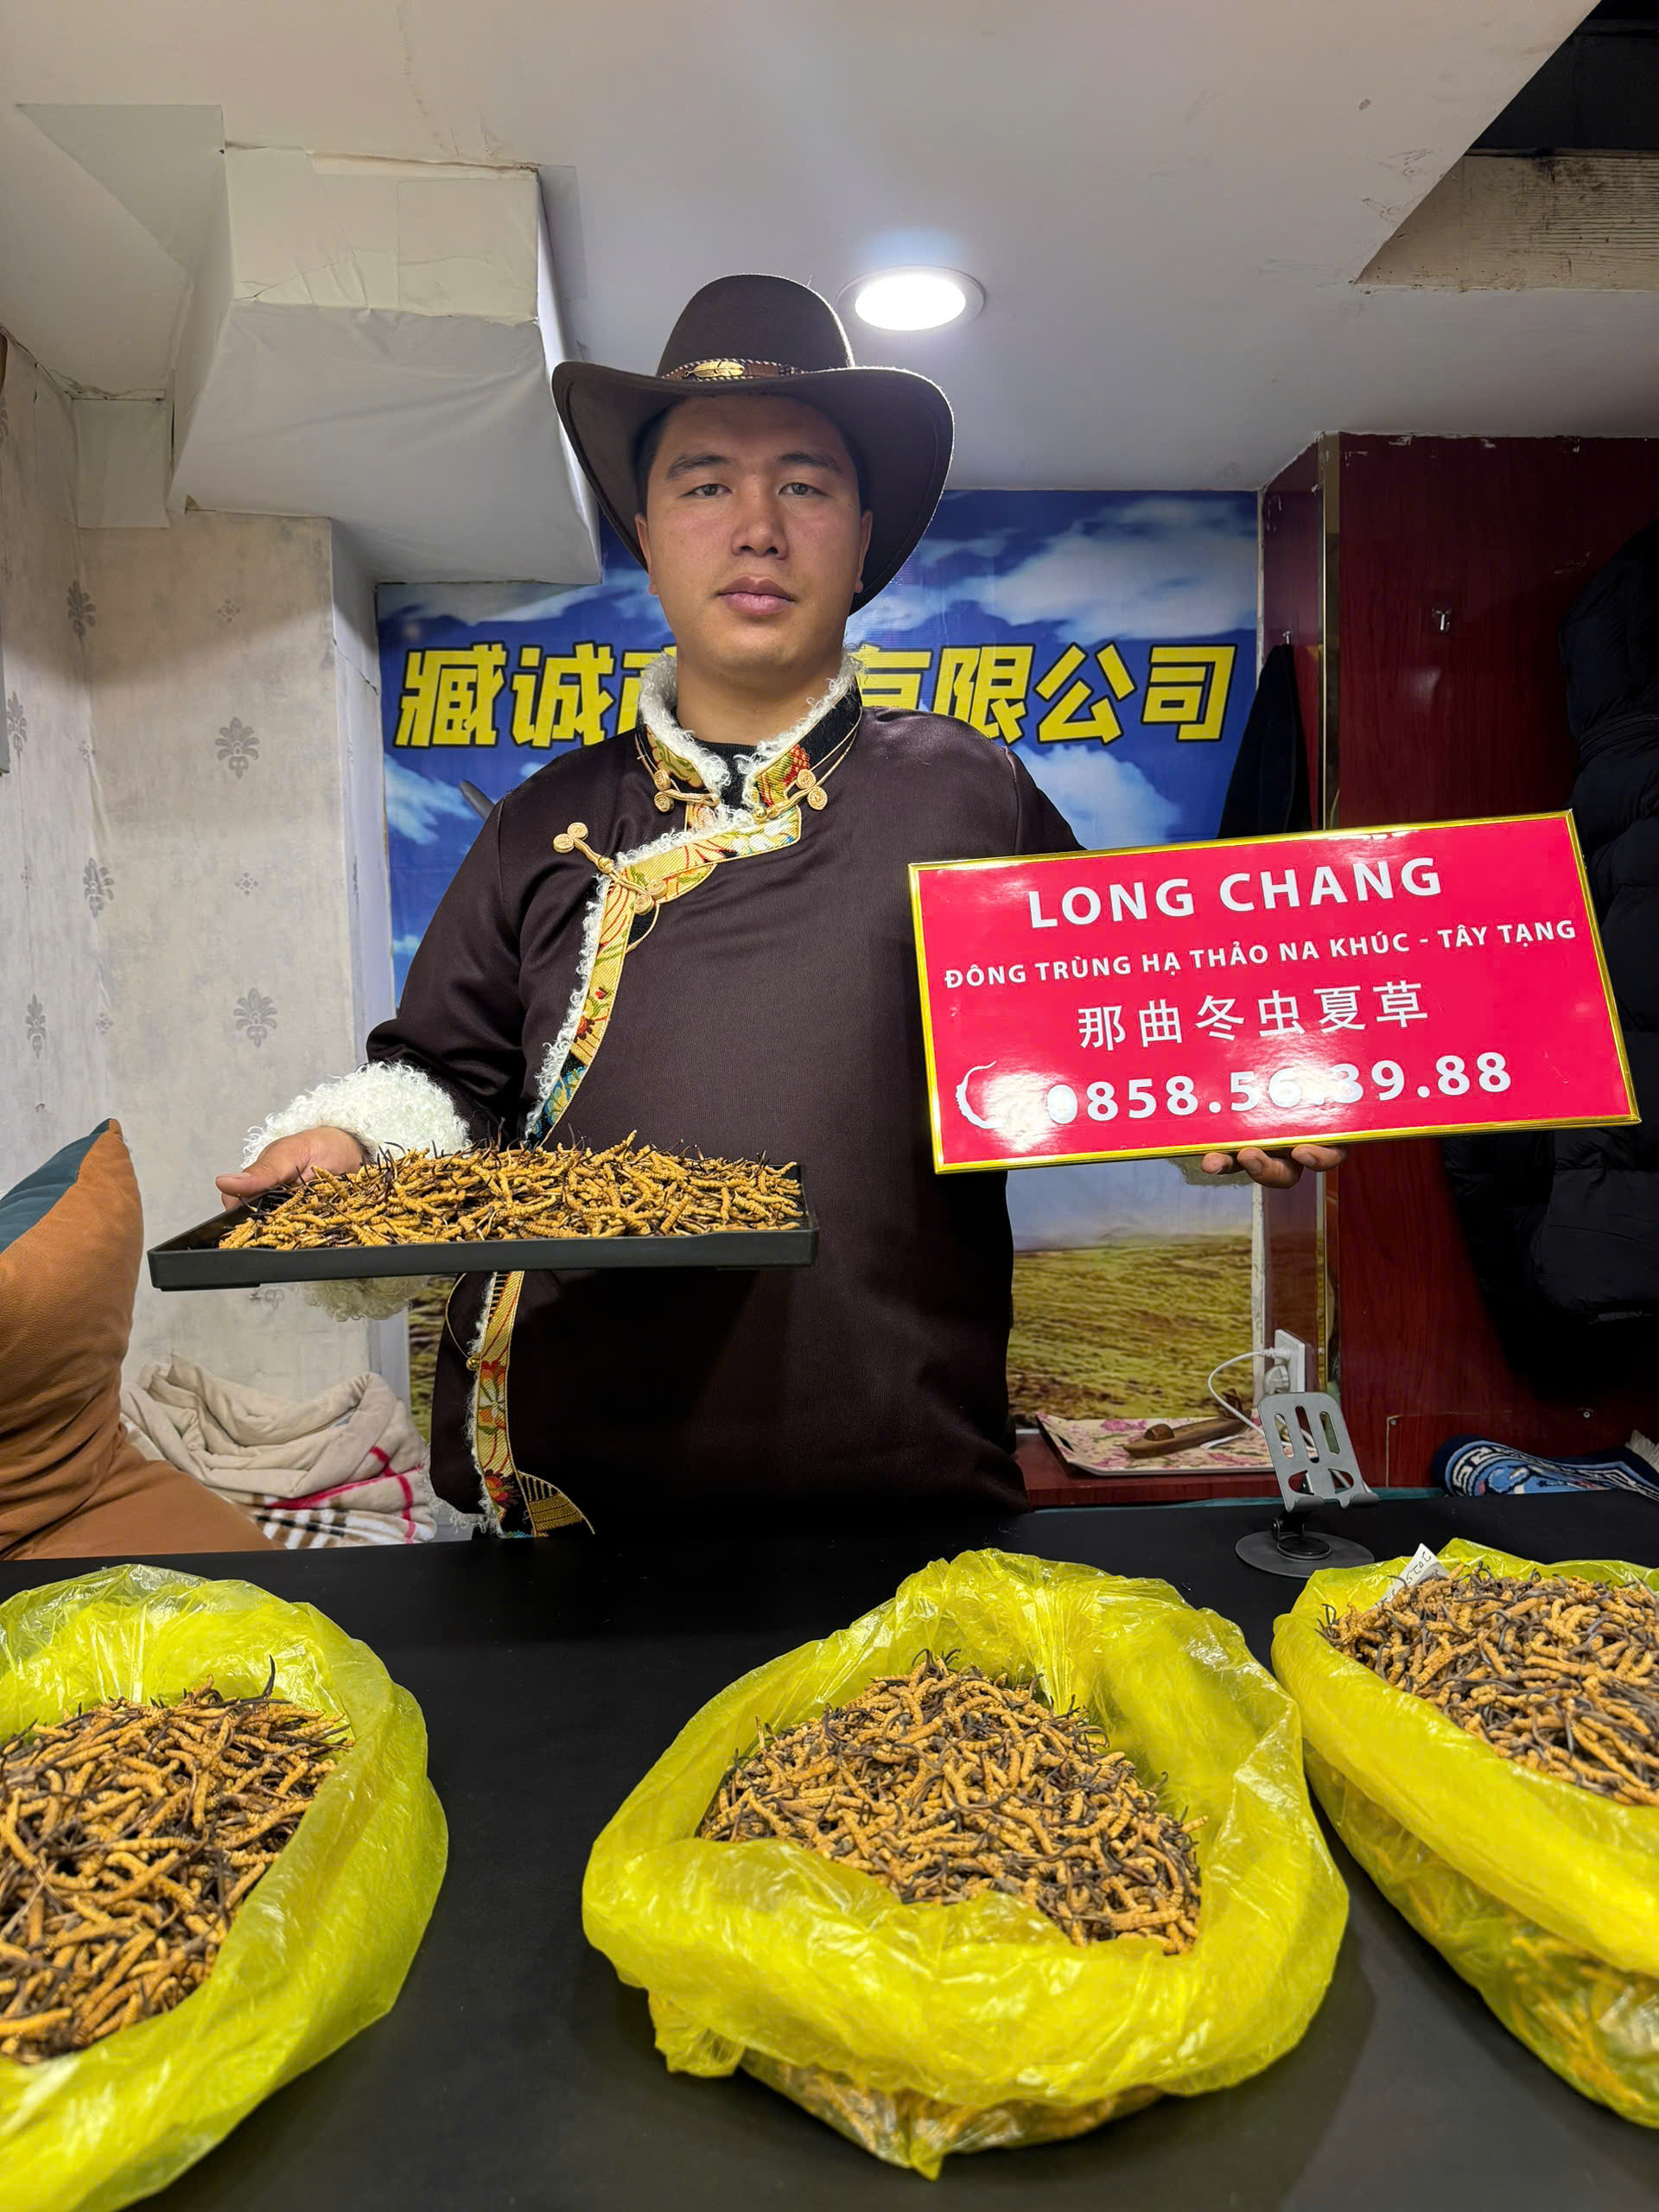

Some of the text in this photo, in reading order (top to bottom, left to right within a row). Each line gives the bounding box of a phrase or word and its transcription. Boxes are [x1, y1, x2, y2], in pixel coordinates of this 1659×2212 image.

[1027, 857, 1442, 929] LONG CHANG
[944, 963, 1027, 989] ĐÔNG
[1034, 955, 1132, 982] TRÙNG
[1141, 951, 1182, 976] HẠ
[1188, 940, 1269, 969] THẢO
[1278, 940, 1320, 962] NA
[1329, 930, 1410, 958] KHÚC
[1437, 924, 1488, 949] TÂY
[1497, 918, 1577, 948] TẠNG
[1077, 979, 1429, 1052] 那曲冬虫夏草
[1046, 1051, 1511, 1125] 0858.56.39.88
